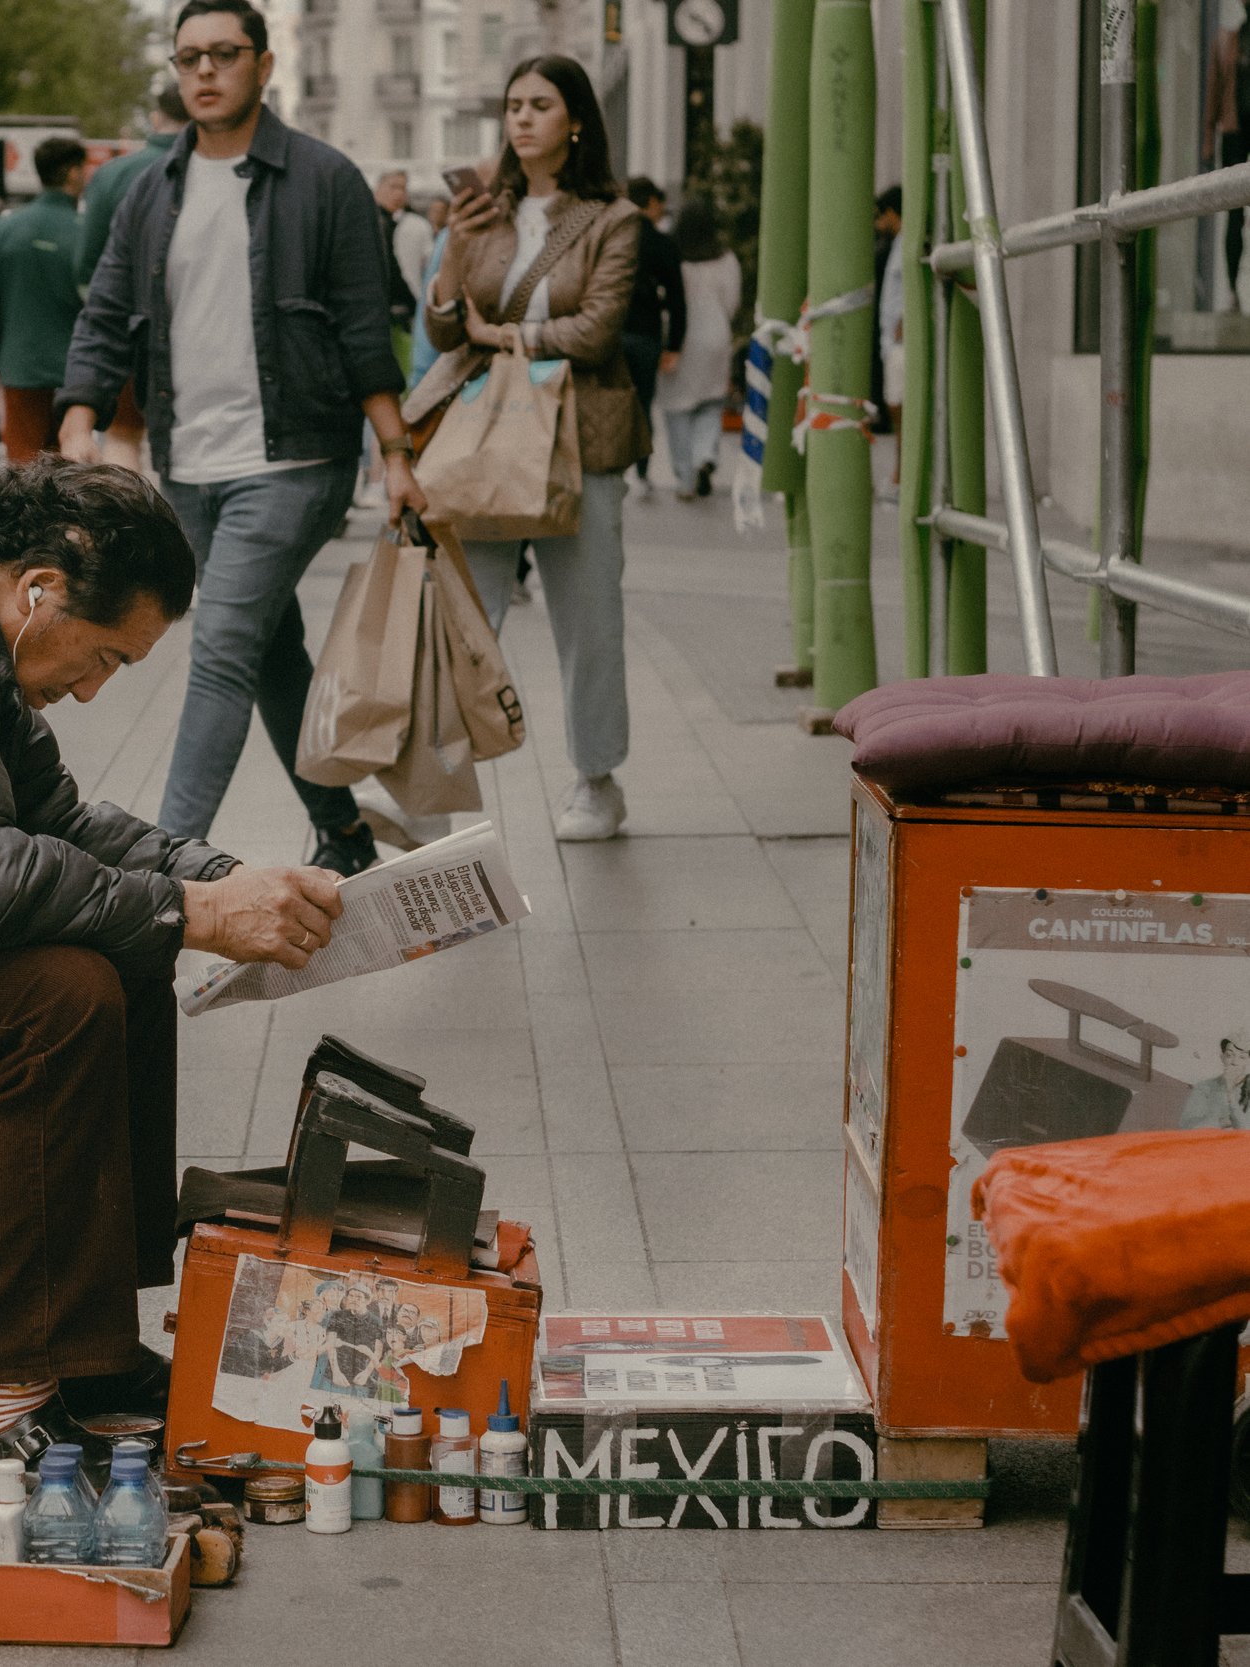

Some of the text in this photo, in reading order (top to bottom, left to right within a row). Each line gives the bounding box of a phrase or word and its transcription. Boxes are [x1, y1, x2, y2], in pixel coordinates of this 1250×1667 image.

[457, 865, 470, 873] El
[417, 876, 431, 890] que
[431, 872, 445, 889] más
[460, 873, 475, 895] tramo
[393, 881, 406, 896] aún
[396, 894, 412, 907] por
[406, 879, 438, 935] muchas disputas
[469, 893, 485, 907] final
[474, 906, 487, 915] de
[1091, 907, 1153, 918] COLECCIÓN
[404, 907, 423, 931] decidir
[1028, 918, 1213, 944] CANTINFLAS
